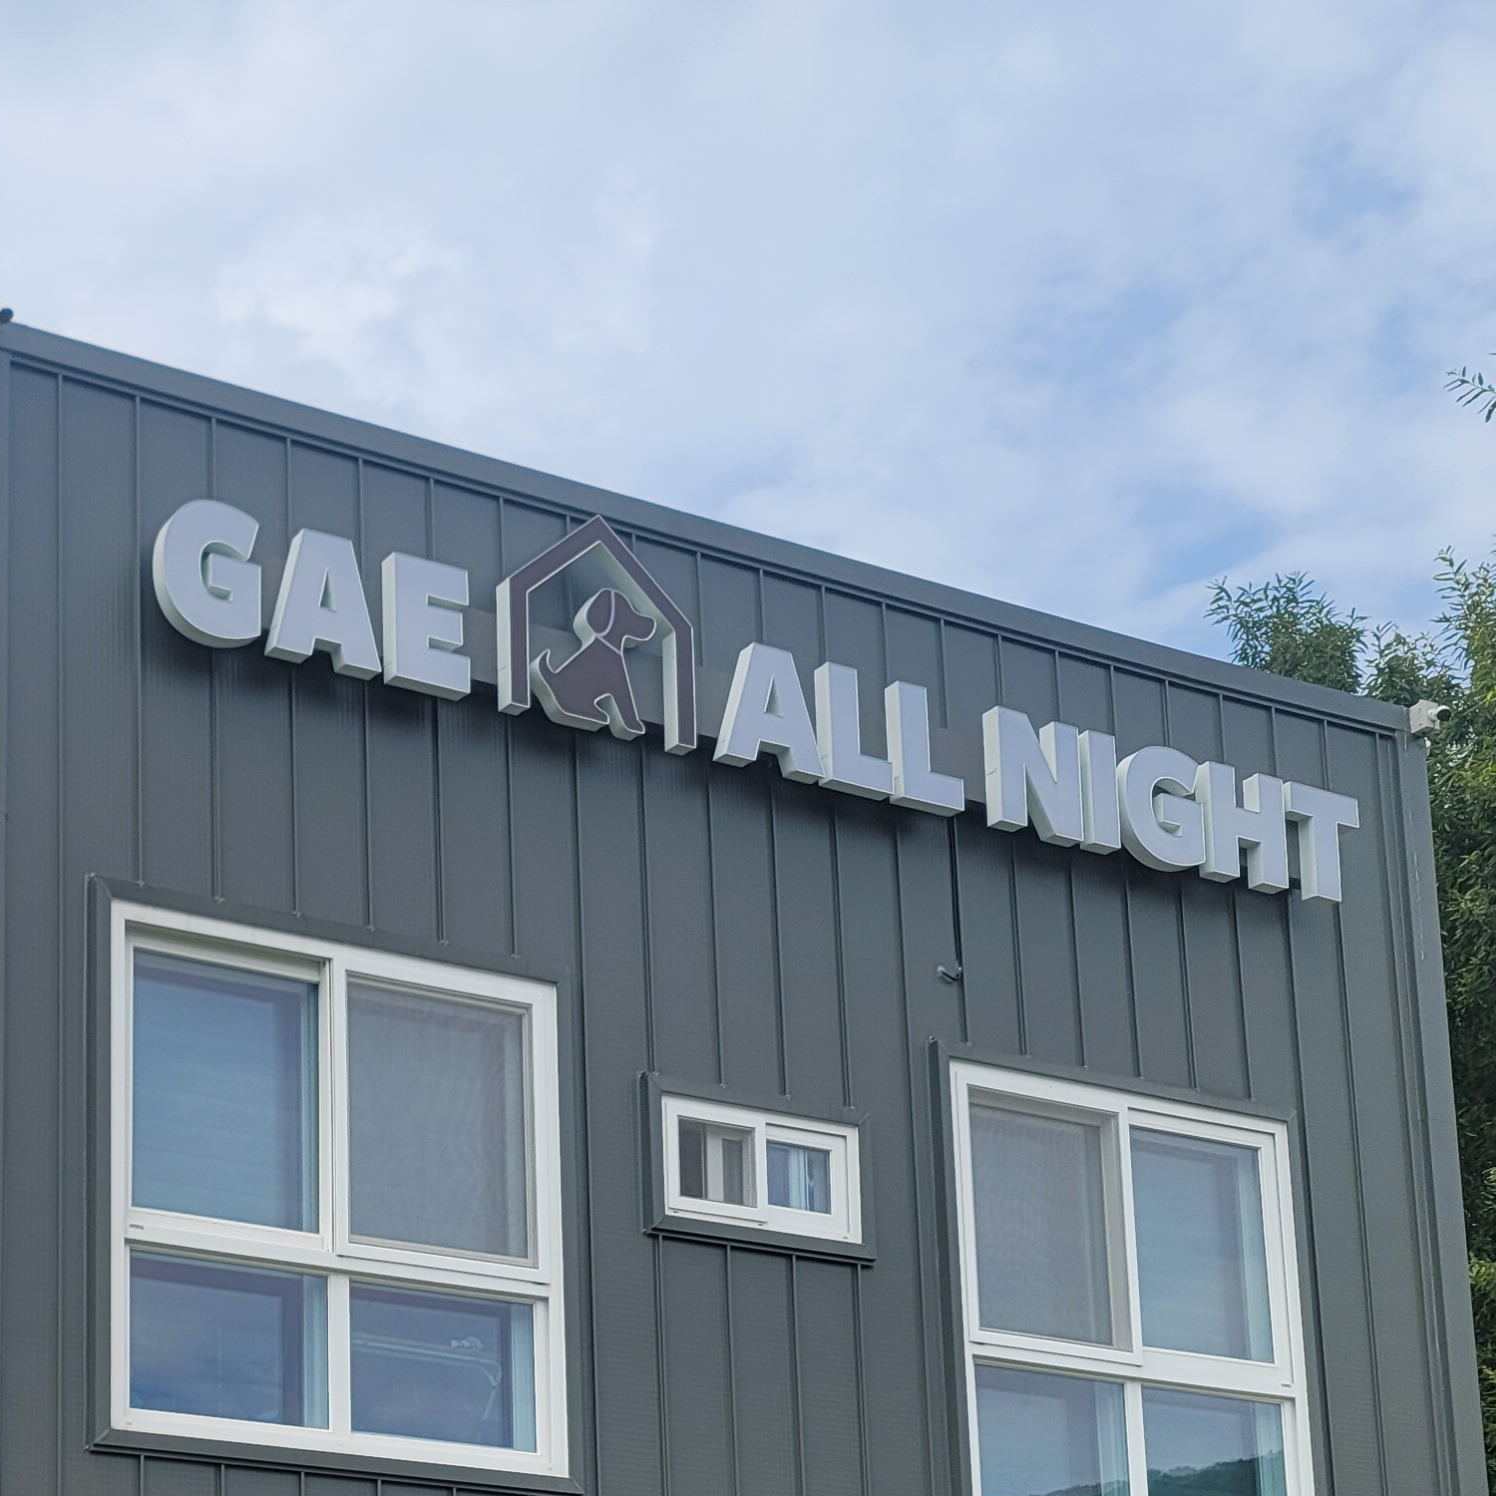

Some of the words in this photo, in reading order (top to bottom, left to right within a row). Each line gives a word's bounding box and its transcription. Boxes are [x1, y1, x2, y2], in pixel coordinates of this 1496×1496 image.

[153, 500, 470, 700] GAE
[712, 641, 965, 818] ALL
[982, 705, 1359, 902] NIGHT
